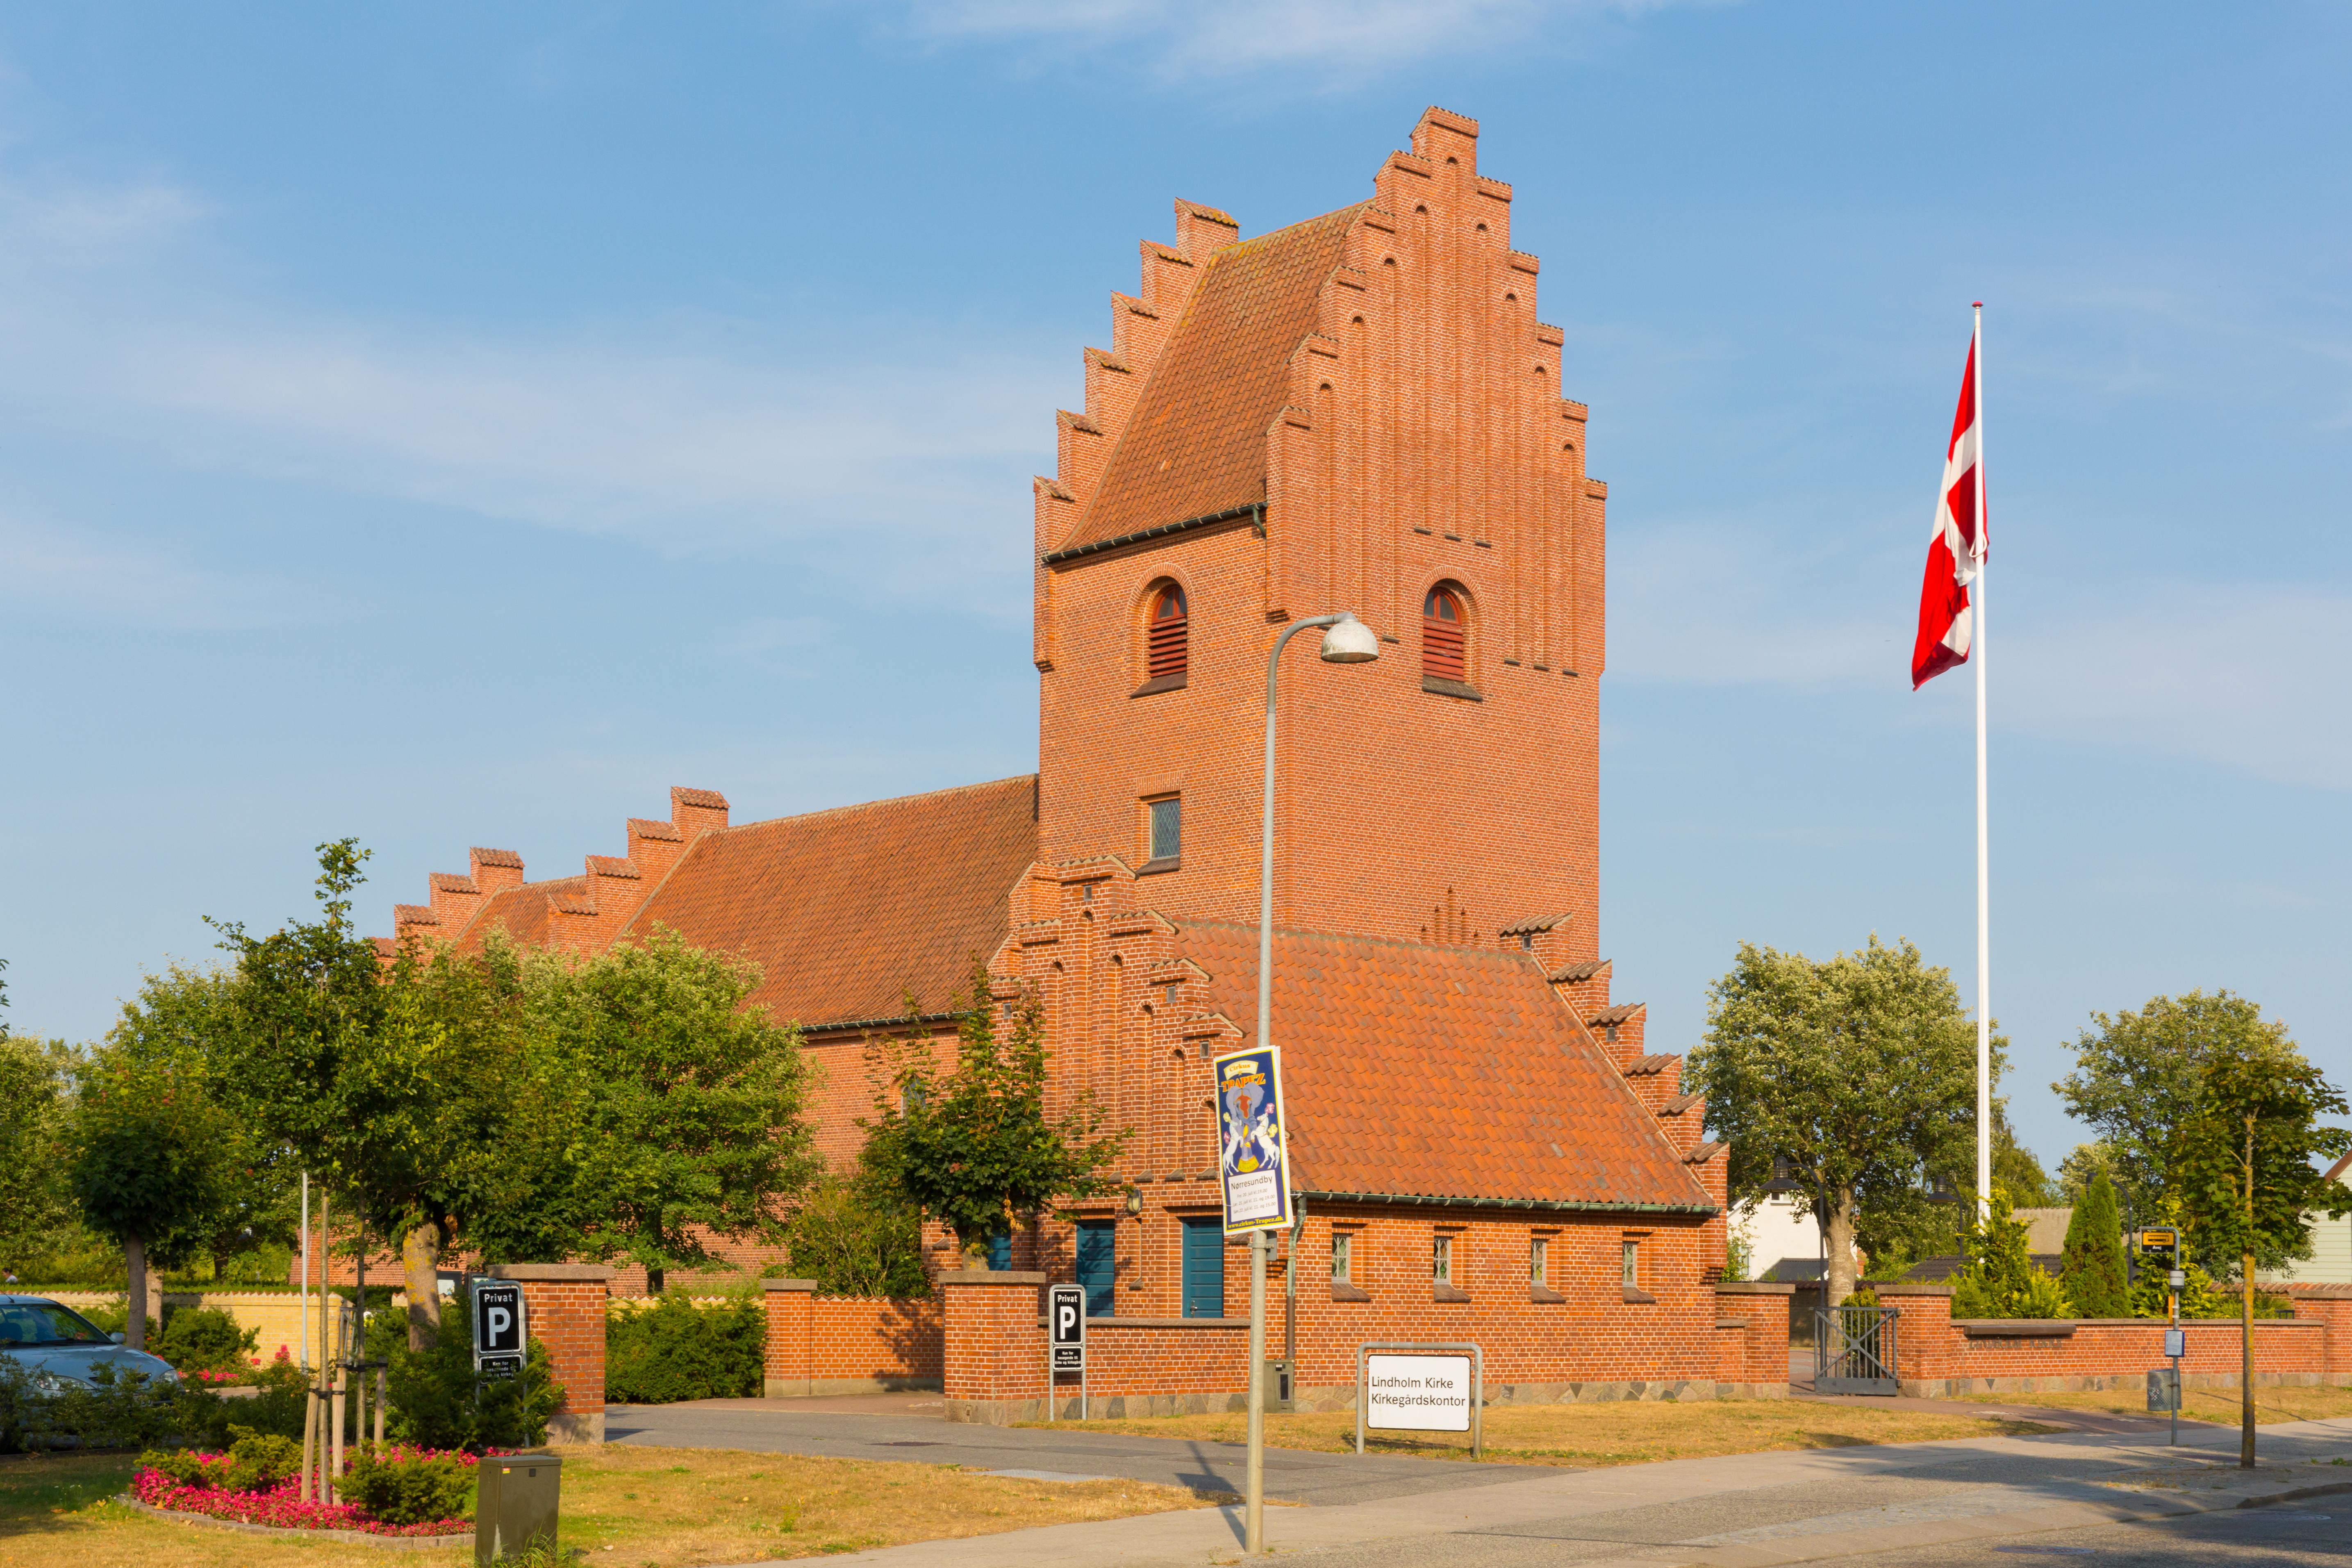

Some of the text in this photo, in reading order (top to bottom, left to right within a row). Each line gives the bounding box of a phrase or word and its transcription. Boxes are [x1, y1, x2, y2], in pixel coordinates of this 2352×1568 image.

[1229, 1064, 1251, 1072] Cirkus
[1221, 1073, 1266, 1092] TRAPEZ
[1231, 1176, 1272, 1190] Nørresundby
[1228, 1215, 1283, 1229] www.cirkus-Trapez.dk
[485, 1293, 512, 1302] Privat
[488, 1307, 511, 1347] P
[1060, 1306, 1076, 1339] P
[1372, 1376, 1454, 1389] Lindholm Kirke
[1372, 1393, 1466, 1408] Kirkegårdskontor
